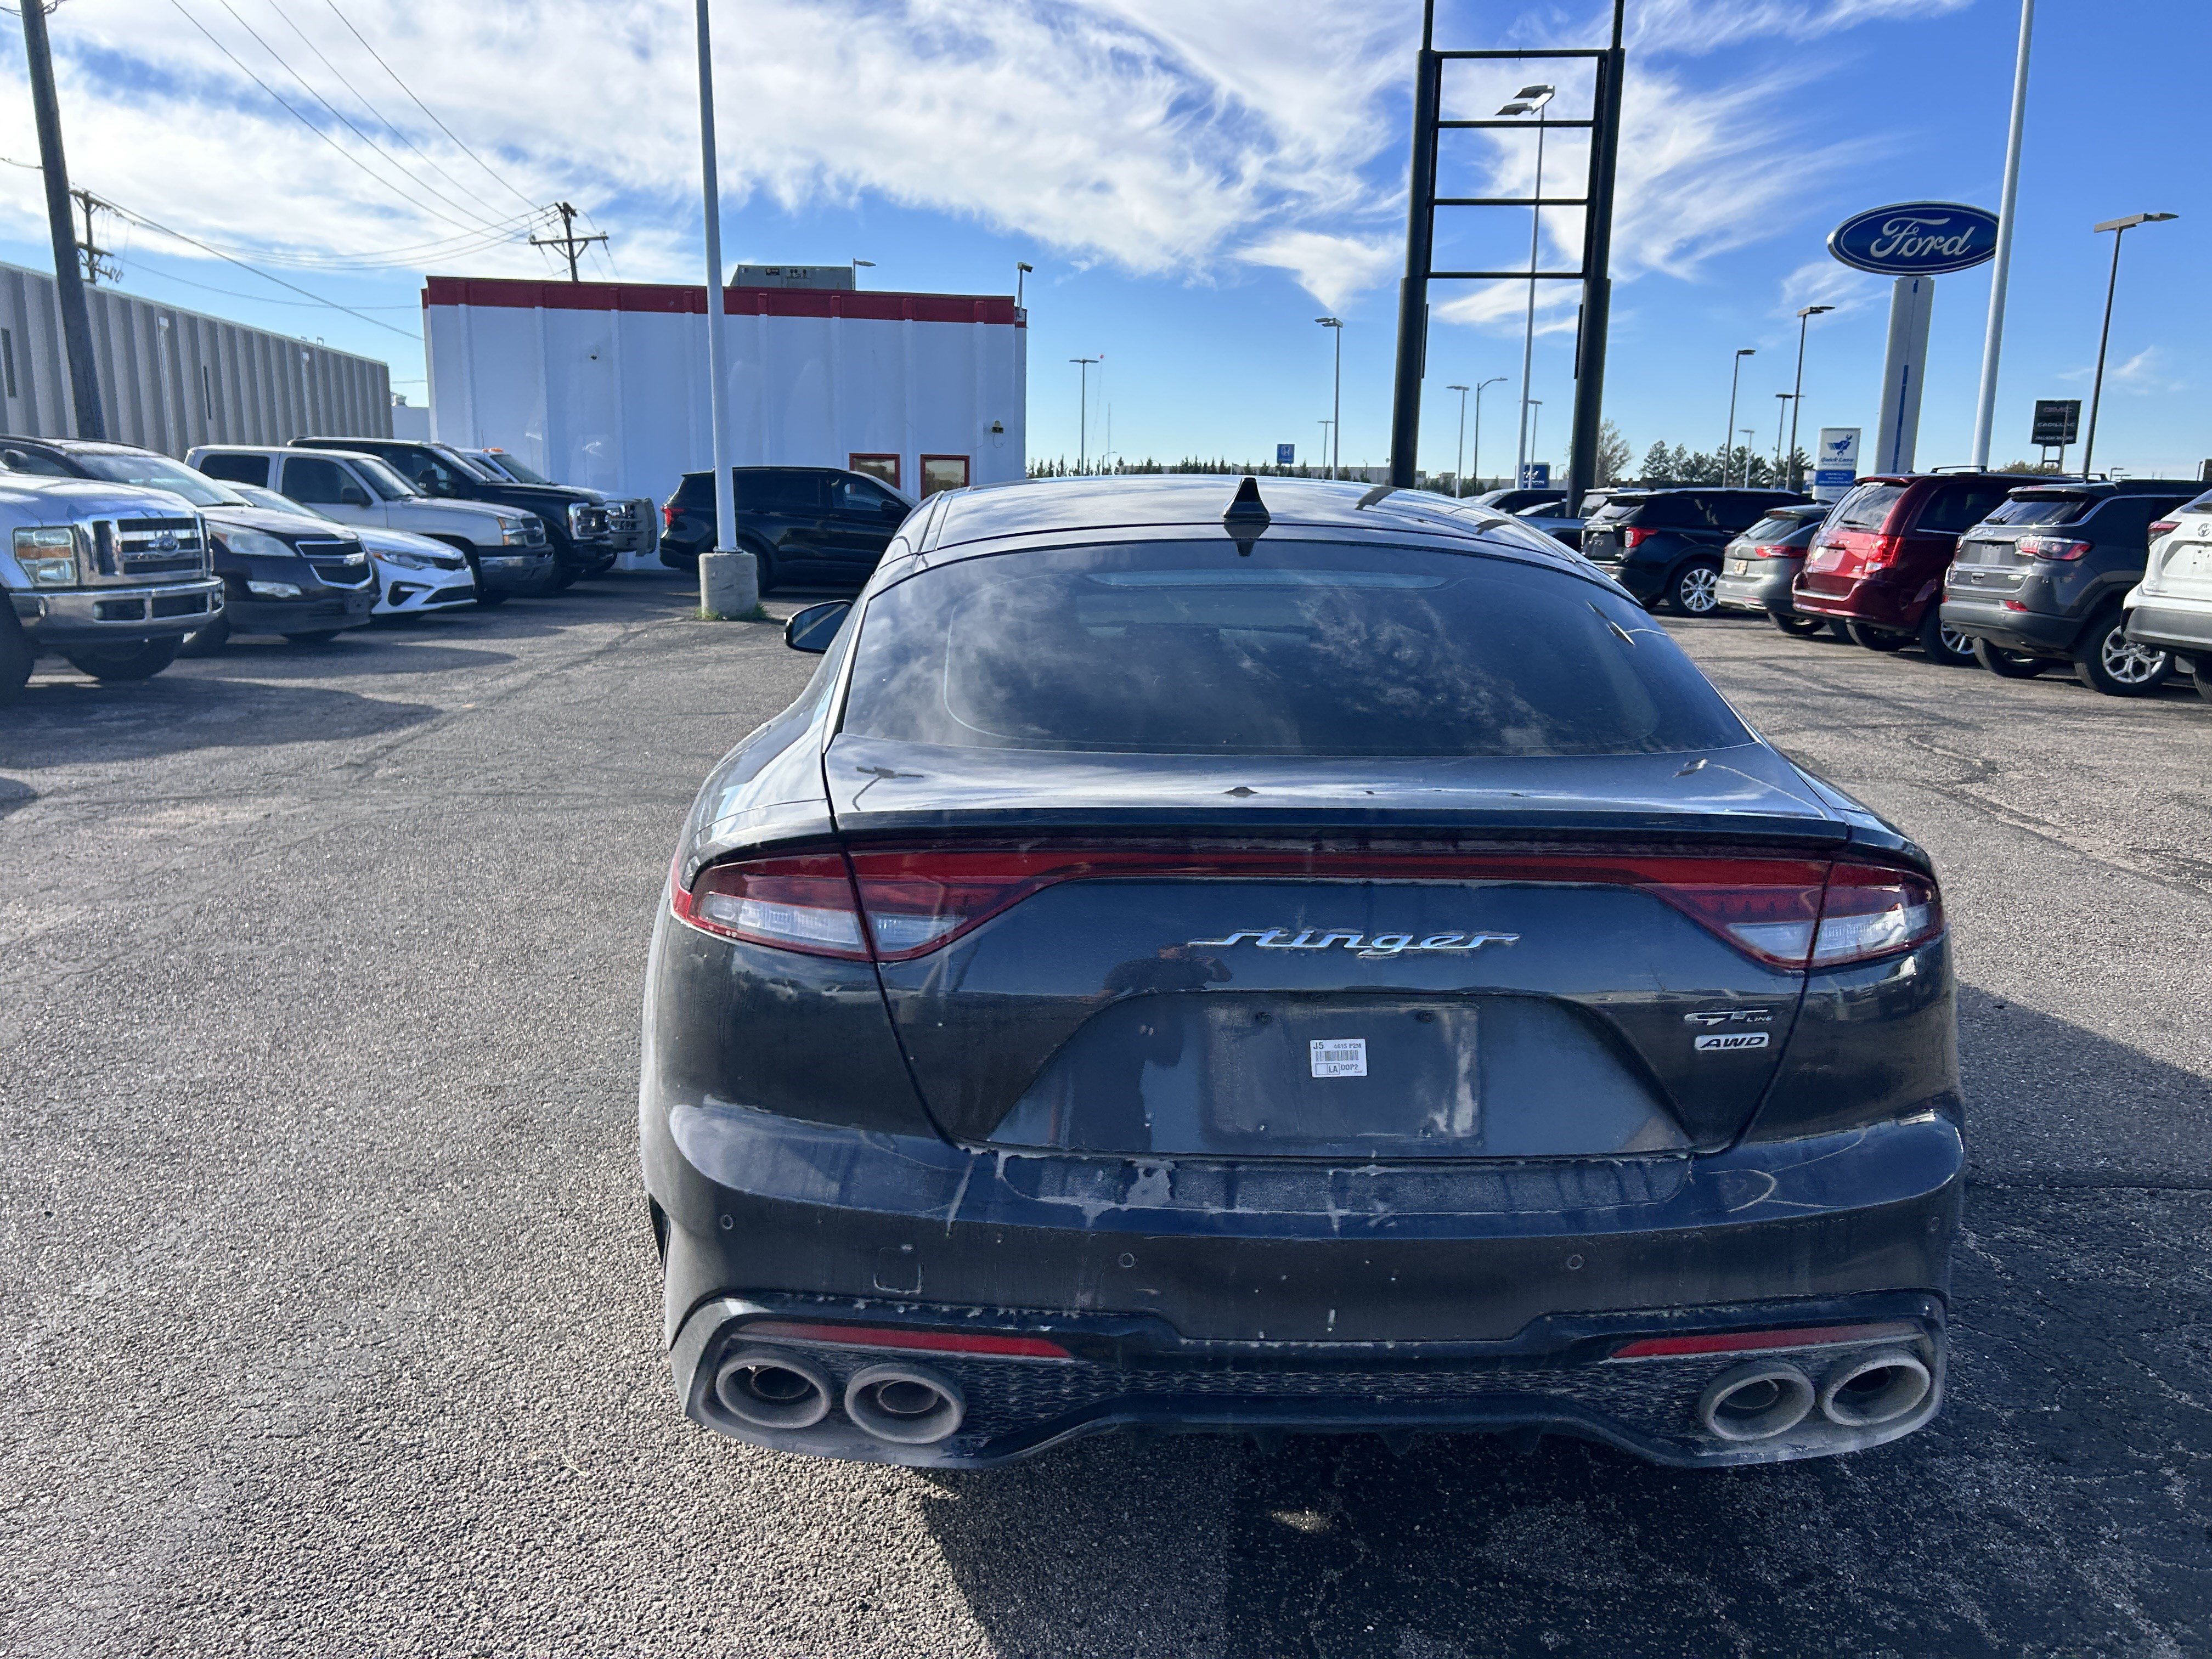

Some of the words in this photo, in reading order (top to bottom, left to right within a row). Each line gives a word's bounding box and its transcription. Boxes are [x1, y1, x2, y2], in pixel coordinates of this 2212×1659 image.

[1870, 217, 1976, 258] Ford
[1700, 1036, 1765, 1048] AWD
[1329, 1065, 1338, 1073] LA
